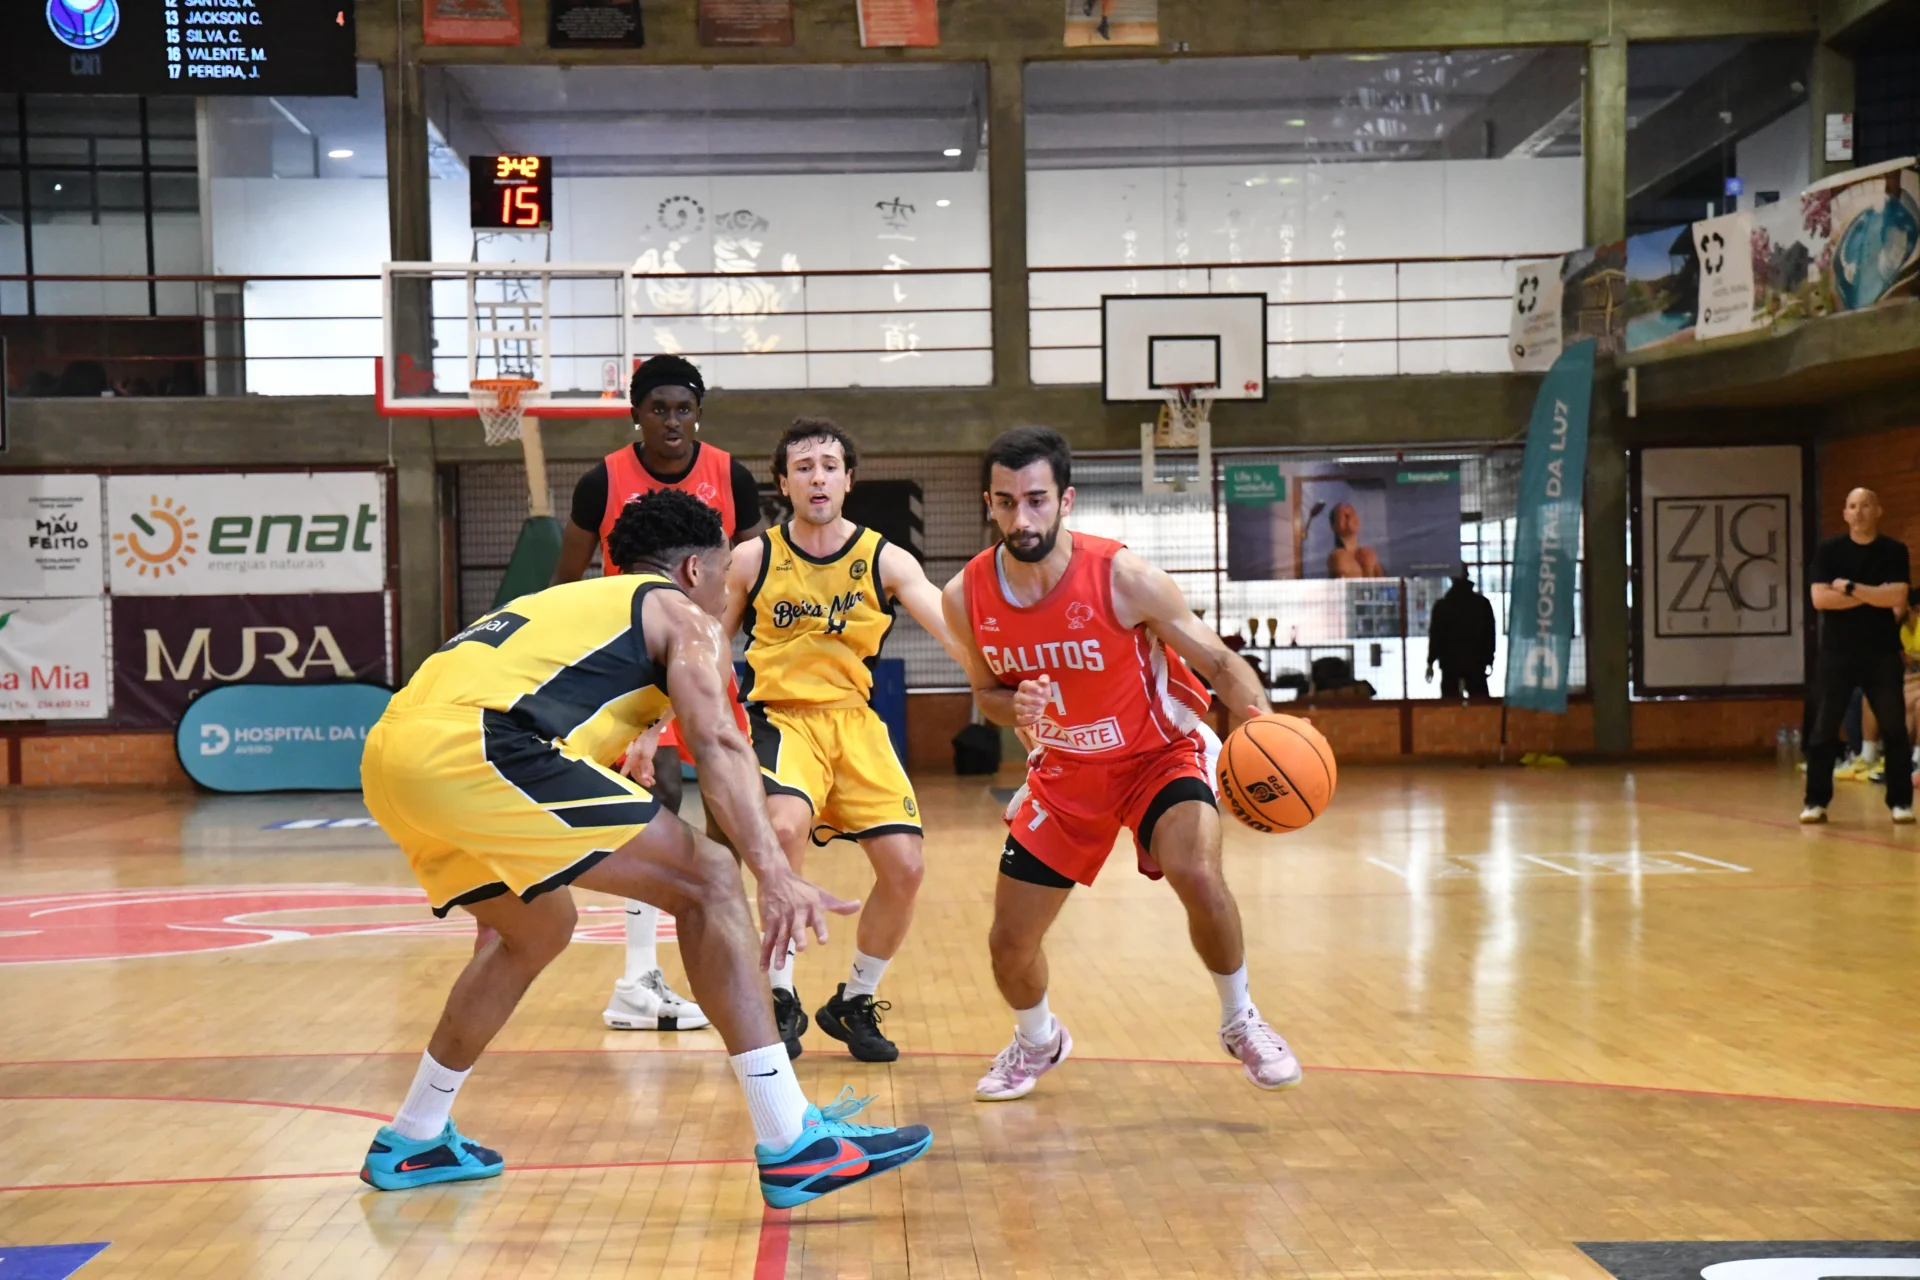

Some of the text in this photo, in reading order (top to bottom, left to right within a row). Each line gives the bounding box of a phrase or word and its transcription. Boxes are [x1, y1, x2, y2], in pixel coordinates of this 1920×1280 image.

[165, 11, 179, 25] 13
[185, 11, 247, 25] JACKSON
[336, 11, 345, 26] 4
[166, 28, 241, 44] 15 SILVA, C.
[167, 47, 267, 62] 16 VALENTE, M.
[168, 64, 181, 78] 17
[188, 65, 246, 79] PEREIRA,
[502, 186, 539, 224] 15
[1550, 400, 1568, 450] LUZ
[1546, 459, 1563, 497] DA
[208, 504, 377, 554] enat
[1667, 503, 1776, 562] ZIG
[208, 559, 325, 573] energias naturais
[1536, 503, 1561, 638] HOSPITAL
[1667, 555, 1777, 612] ZAG
[144, 626, 355, 681] MURA
[982, 639, 1105, 675] GALITOS
[0, 665, 89, 690] a Mia
[235, 725, 325, 742] HOSPITAL
[329, 725, 356, 740] DA
[1220, 769, 1272, 832] Wilson
[1267, 775, 1289, 797] FPB
